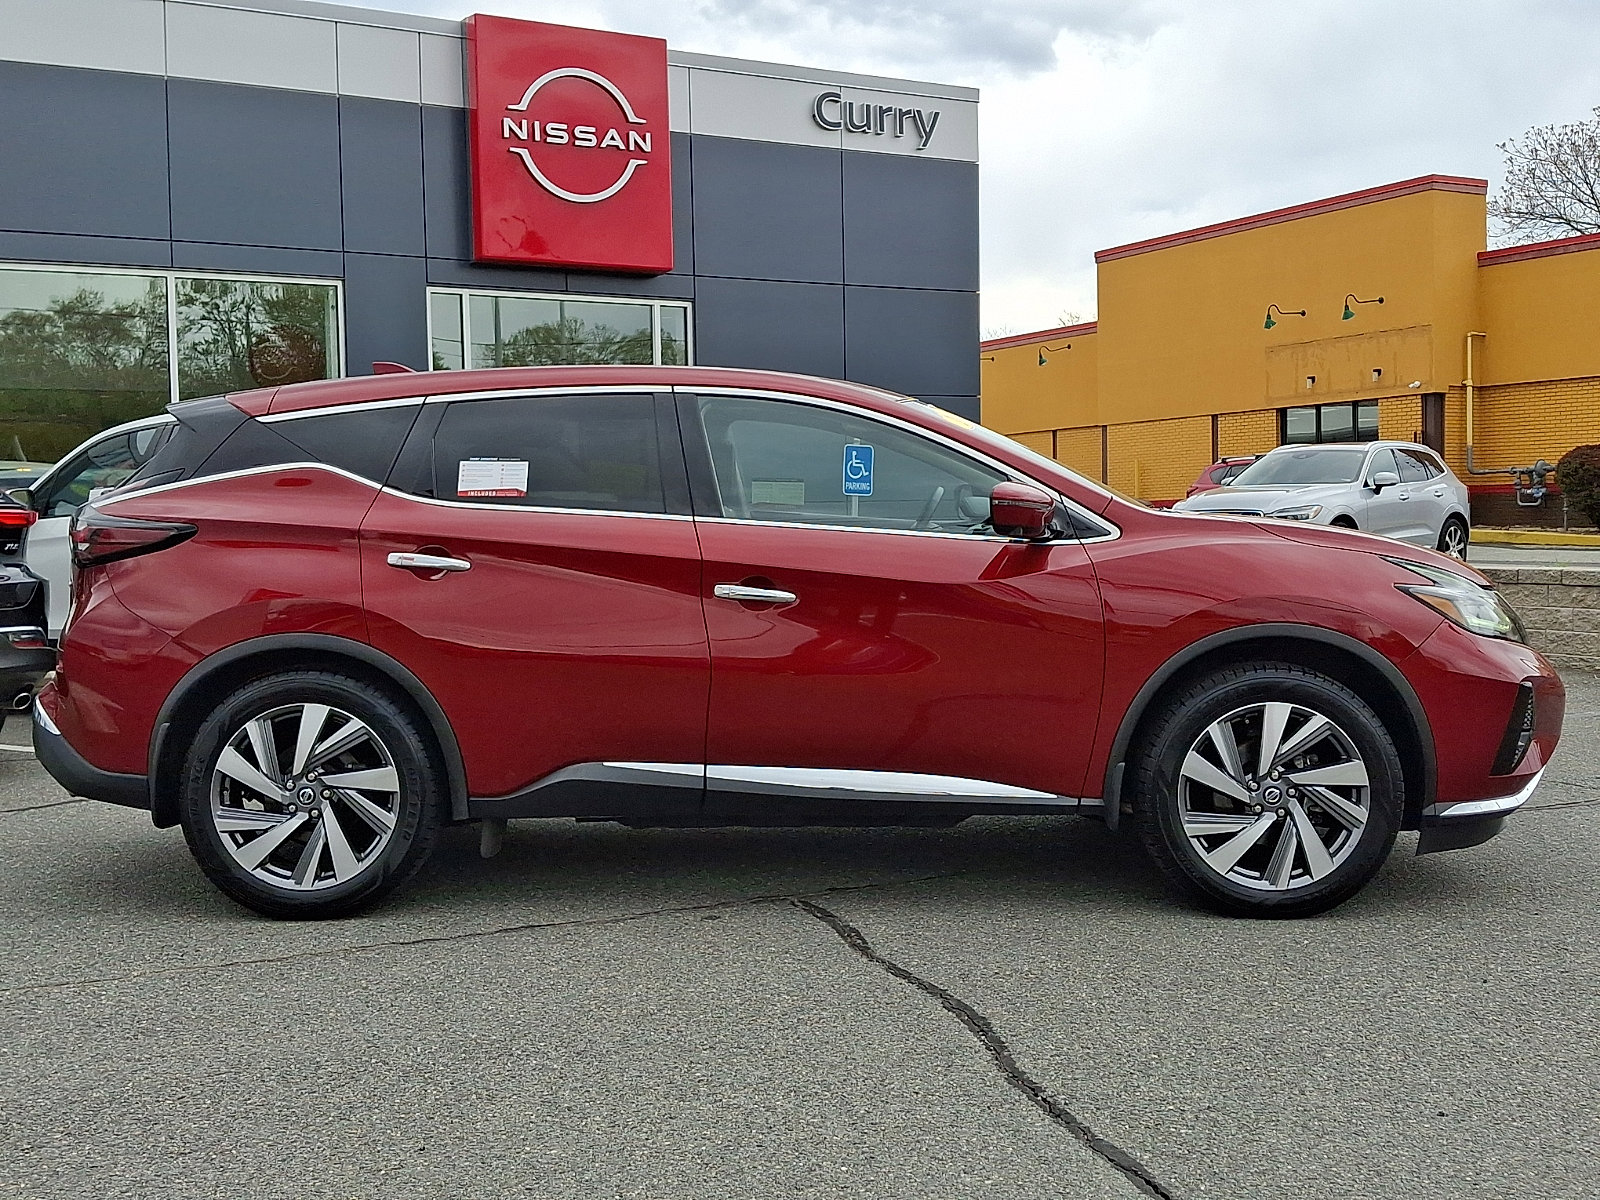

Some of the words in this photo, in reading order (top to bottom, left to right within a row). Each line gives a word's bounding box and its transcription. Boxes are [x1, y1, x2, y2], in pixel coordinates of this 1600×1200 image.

[503, 117, 652, 152] NISSAN
[813, 91, 941, 150] Curry
[845, 481, 871, 491] PARKING
